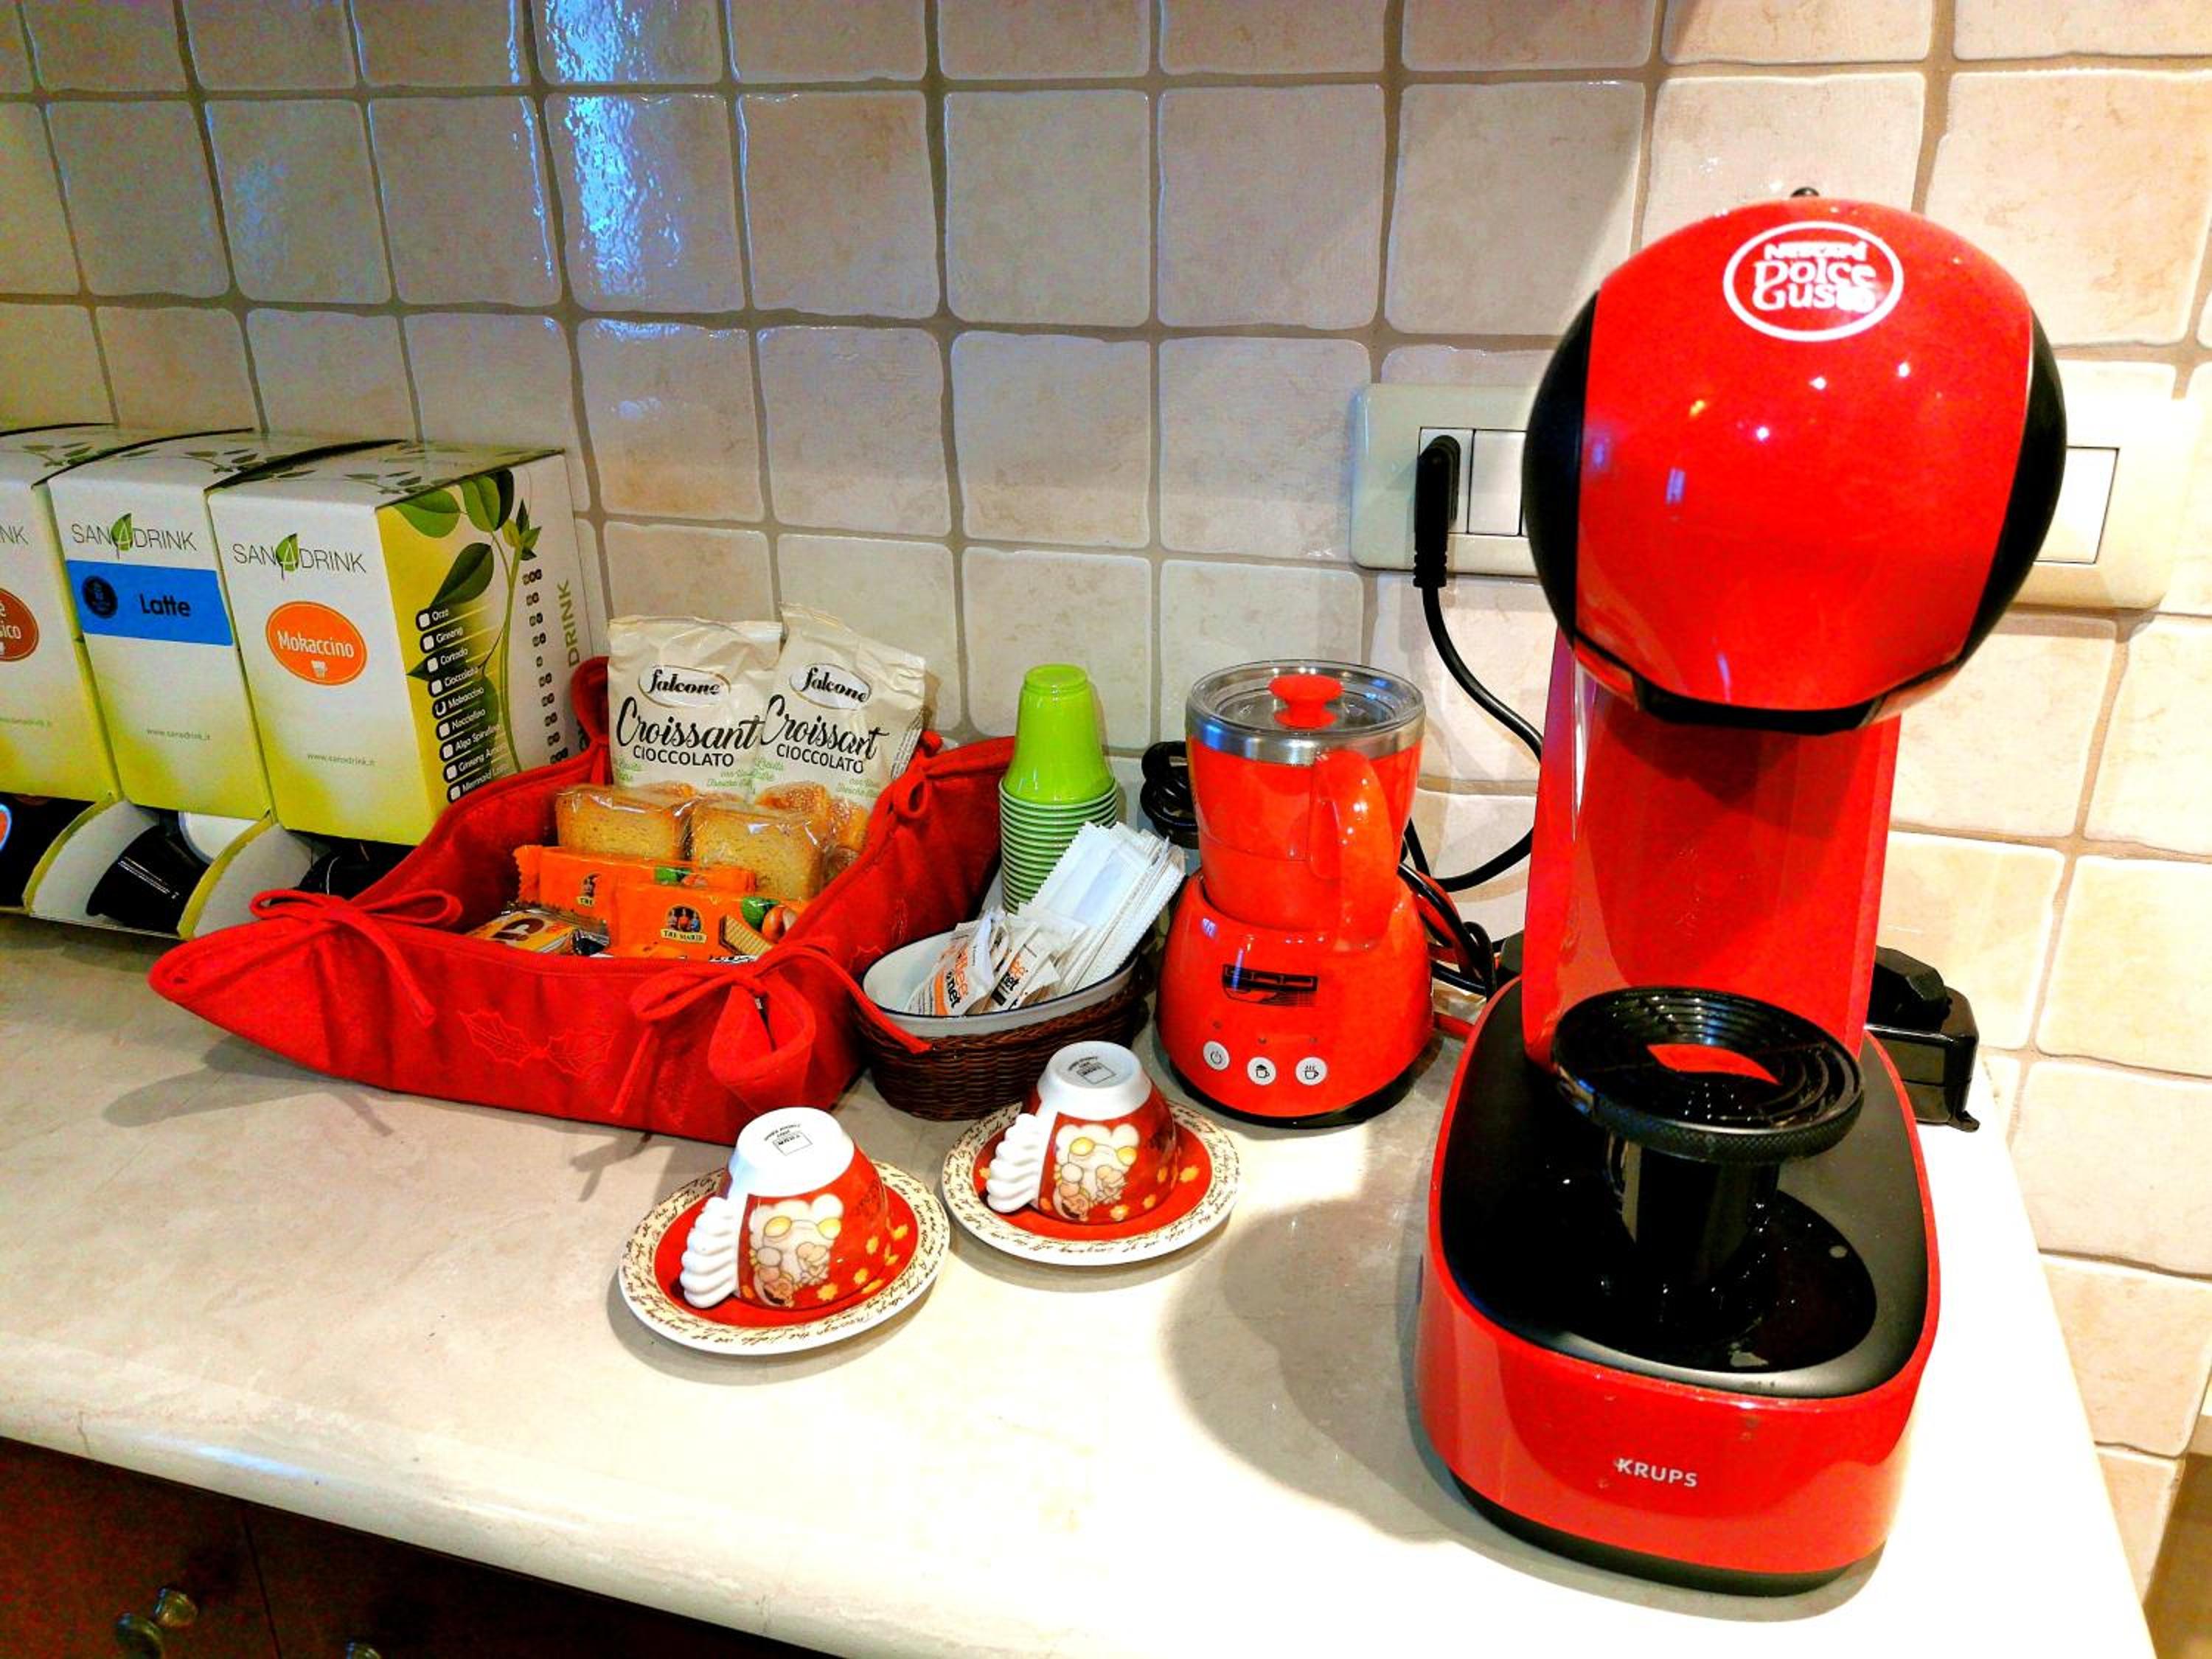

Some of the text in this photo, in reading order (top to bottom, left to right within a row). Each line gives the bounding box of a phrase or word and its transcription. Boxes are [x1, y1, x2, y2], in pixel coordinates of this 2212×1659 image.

[1753, 258, 1877, 288] Dolce
[139, 593, 192, 617] Latte
[276, 630, 355, 659] Mokaccino
[649, 669, 720, 695] falcone
[800, 667, 868, 703] falcone
[616, 696, 765, 751] Croissant
[633, 745, 734, 768] CIOCCOLATO
[776, 743, 864, 774] CIOCCOLATO
[1616, 1458, 1698, 1488] KRUPS
